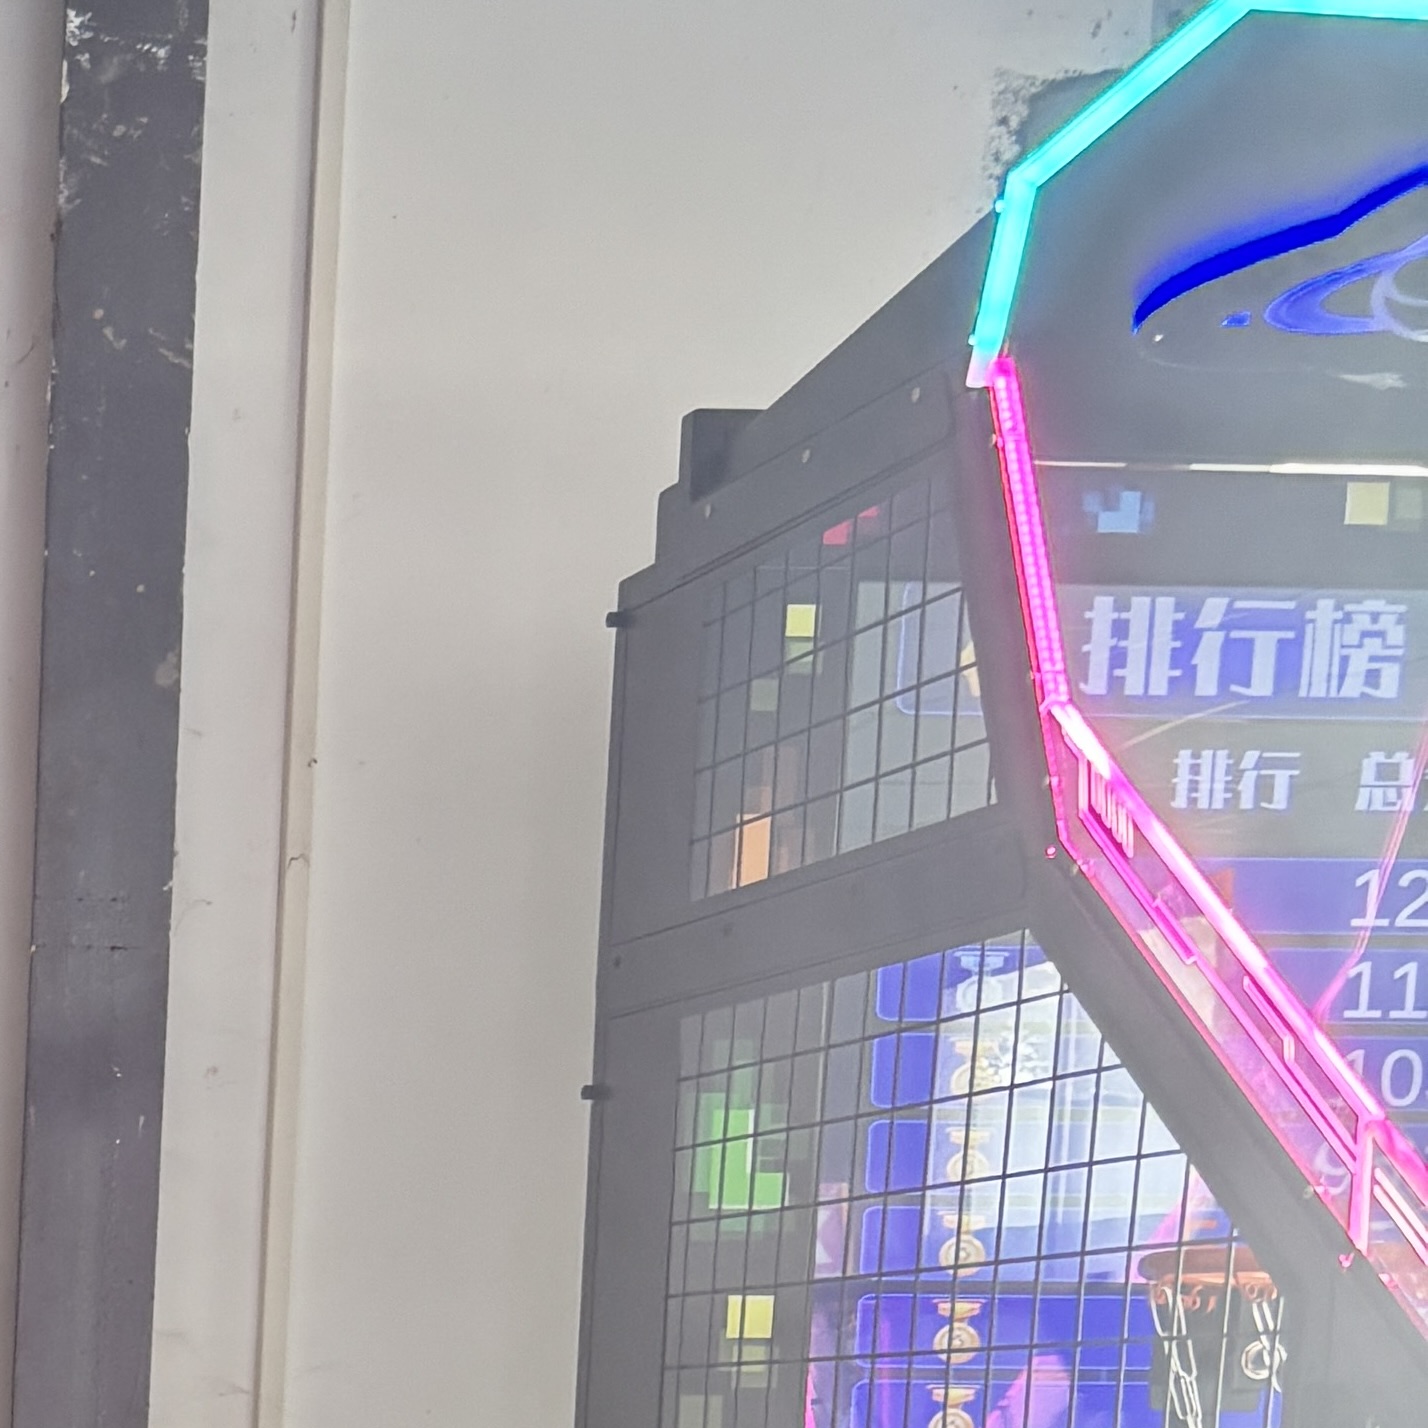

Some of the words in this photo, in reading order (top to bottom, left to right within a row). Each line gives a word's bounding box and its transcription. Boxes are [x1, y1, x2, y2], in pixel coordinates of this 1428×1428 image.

[1080, 595, 1410, 699] 排行榜
[1170, 748, 1301, 810] 排行
[1355, 749, 1428, 812] 总
